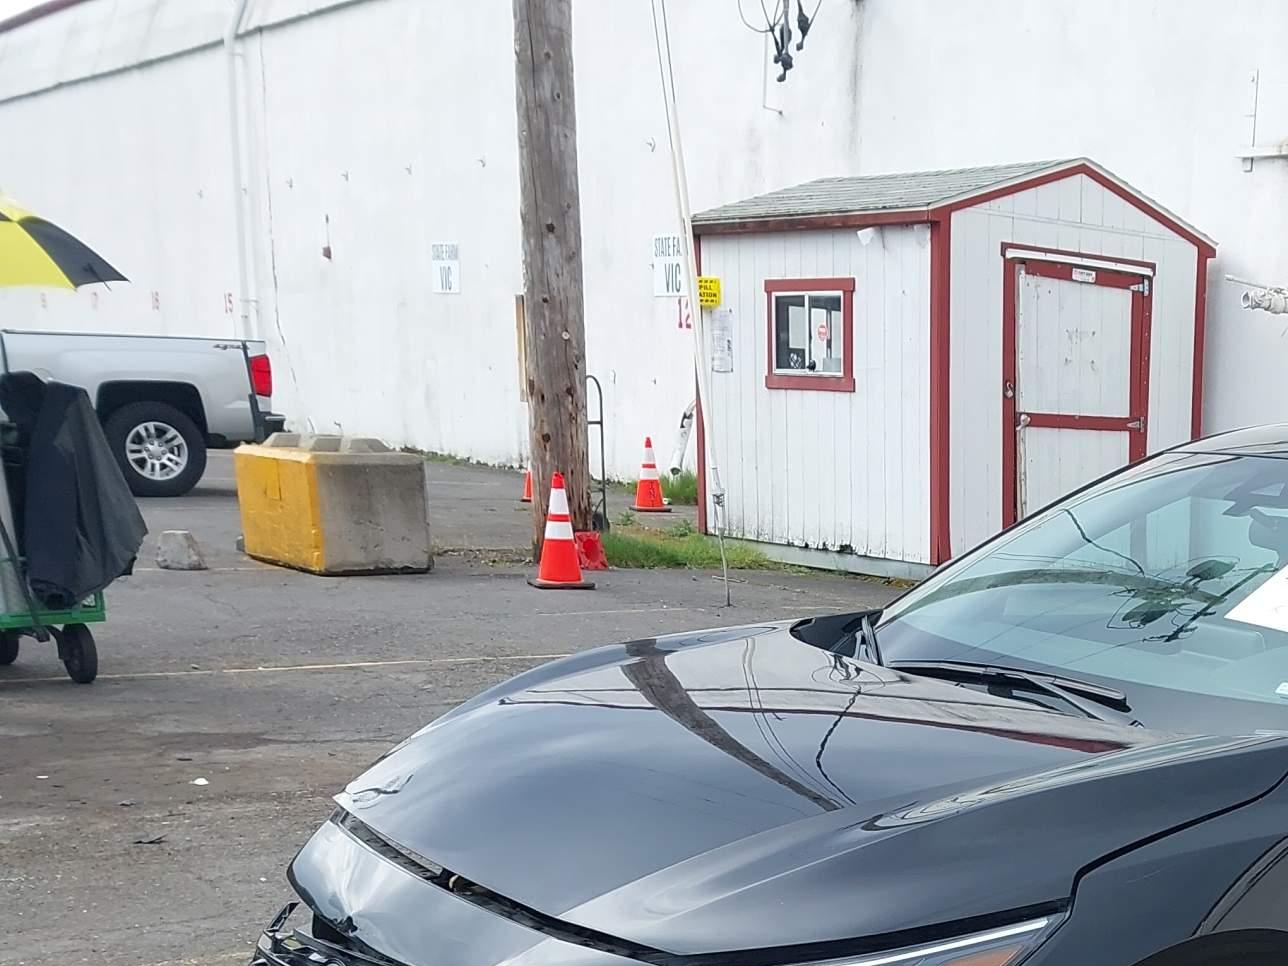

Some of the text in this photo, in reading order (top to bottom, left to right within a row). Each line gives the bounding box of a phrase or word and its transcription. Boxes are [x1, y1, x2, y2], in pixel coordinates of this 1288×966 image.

[654, 236, 671, 257] STATE
[440, 266, 453, 290] VIC
[664, 263, 682, 293] VIC
